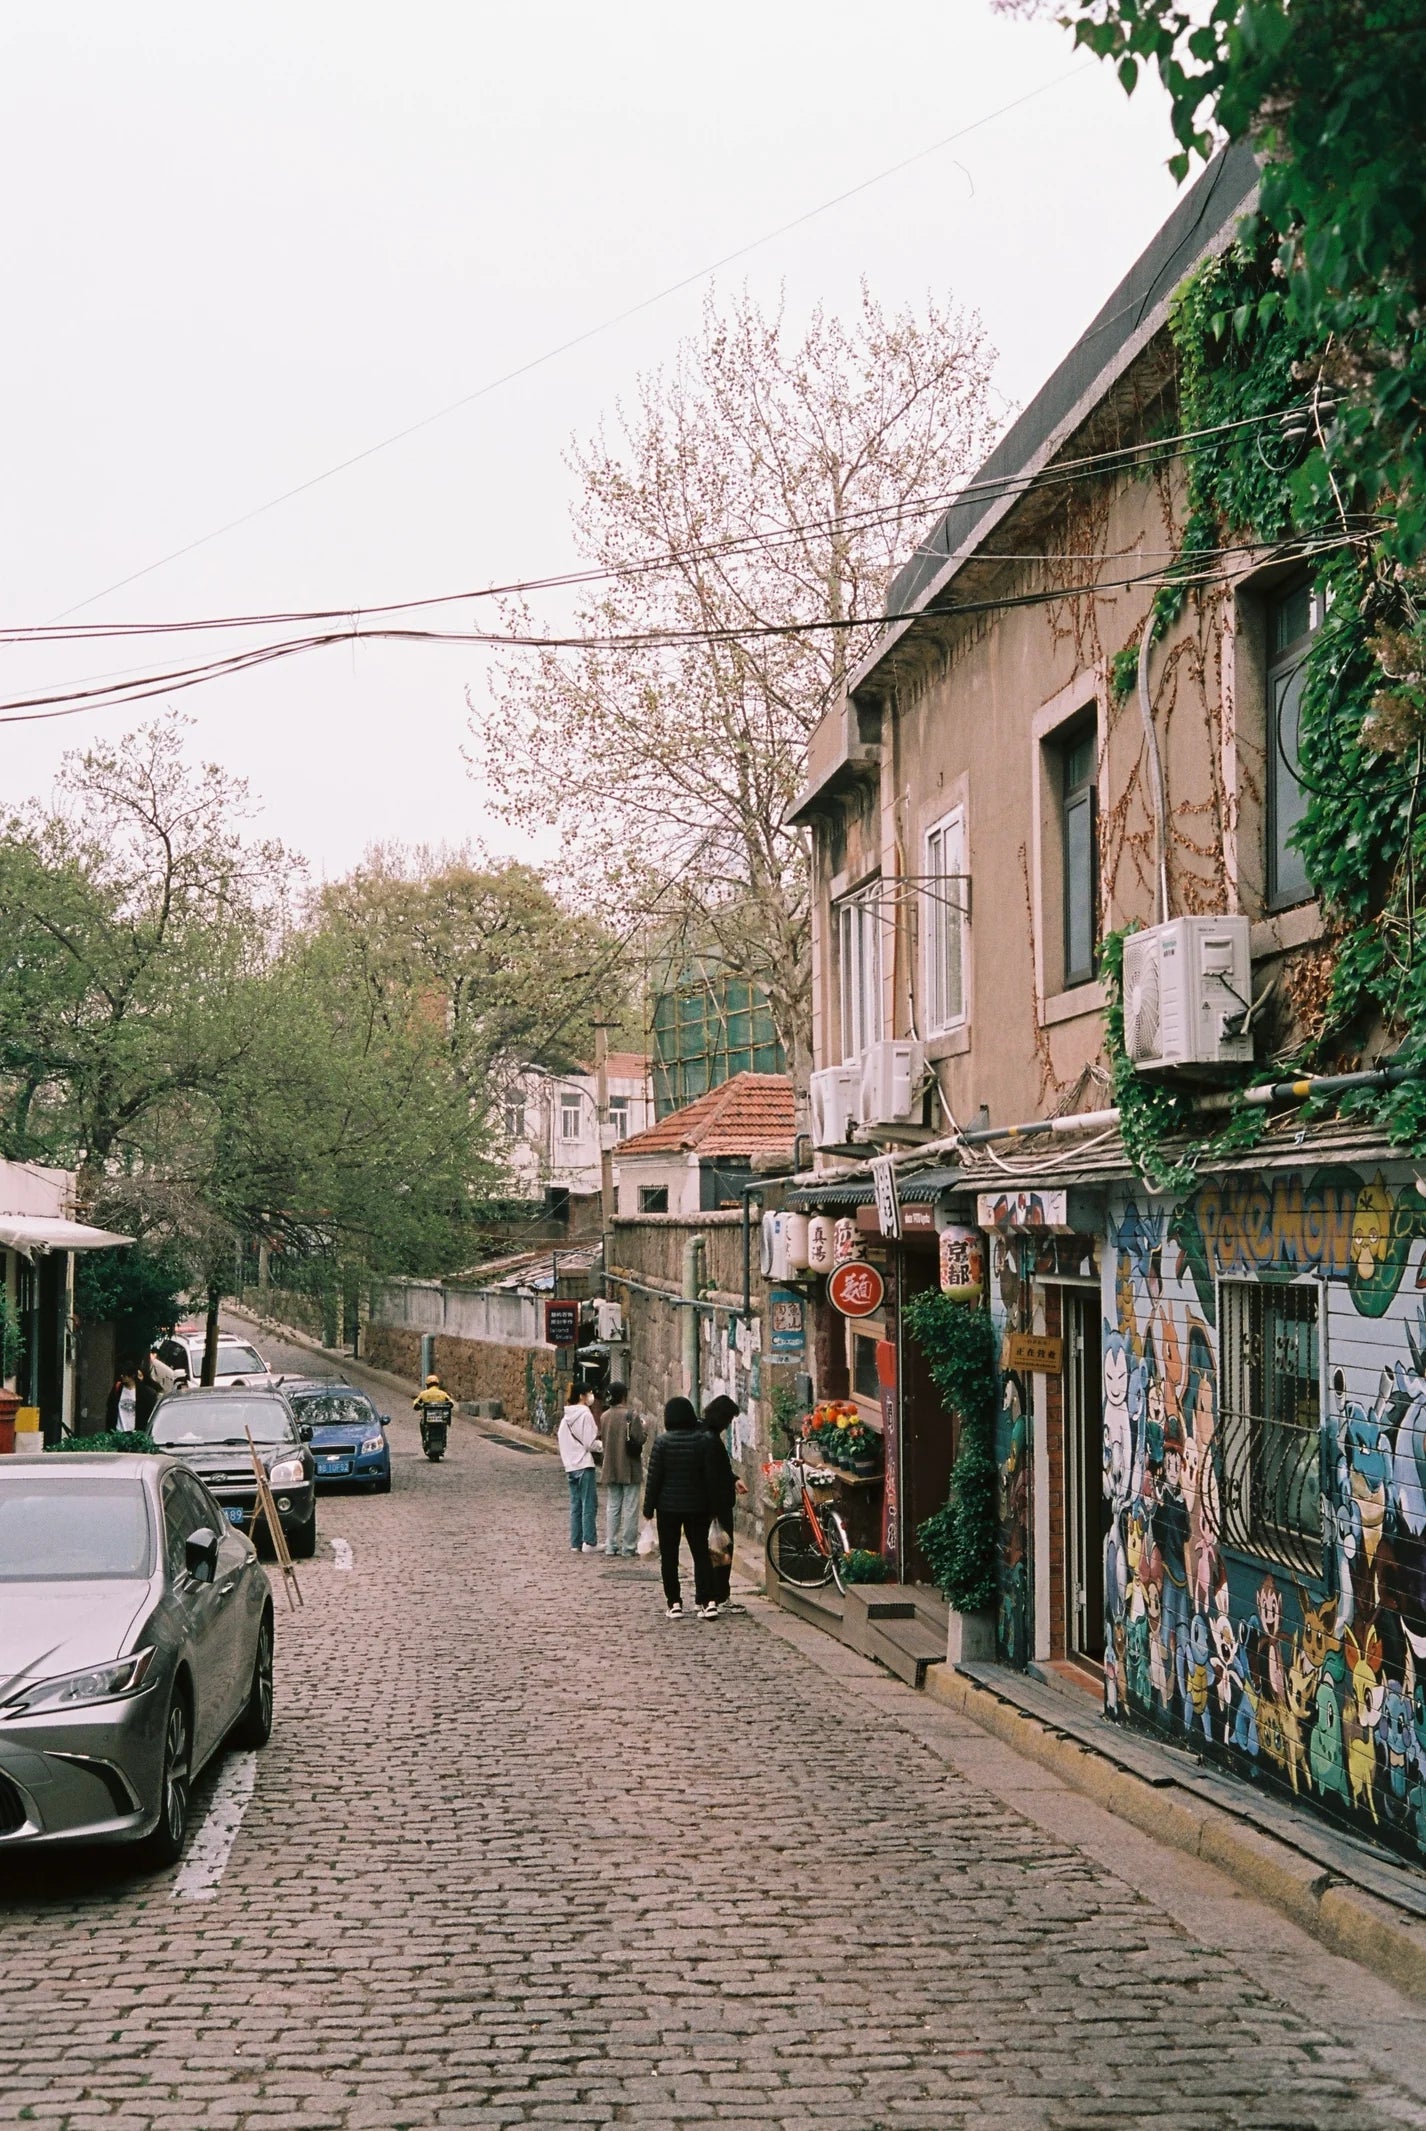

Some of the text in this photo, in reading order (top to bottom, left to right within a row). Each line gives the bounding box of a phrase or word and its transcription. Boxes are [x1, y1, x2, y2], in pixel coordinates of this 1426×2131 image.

[812, 1226, 827, 1262] 真湯
[947, 1240, 970, 1285] 京都
[1016, 1347, 1056, 1359] 正在营业
